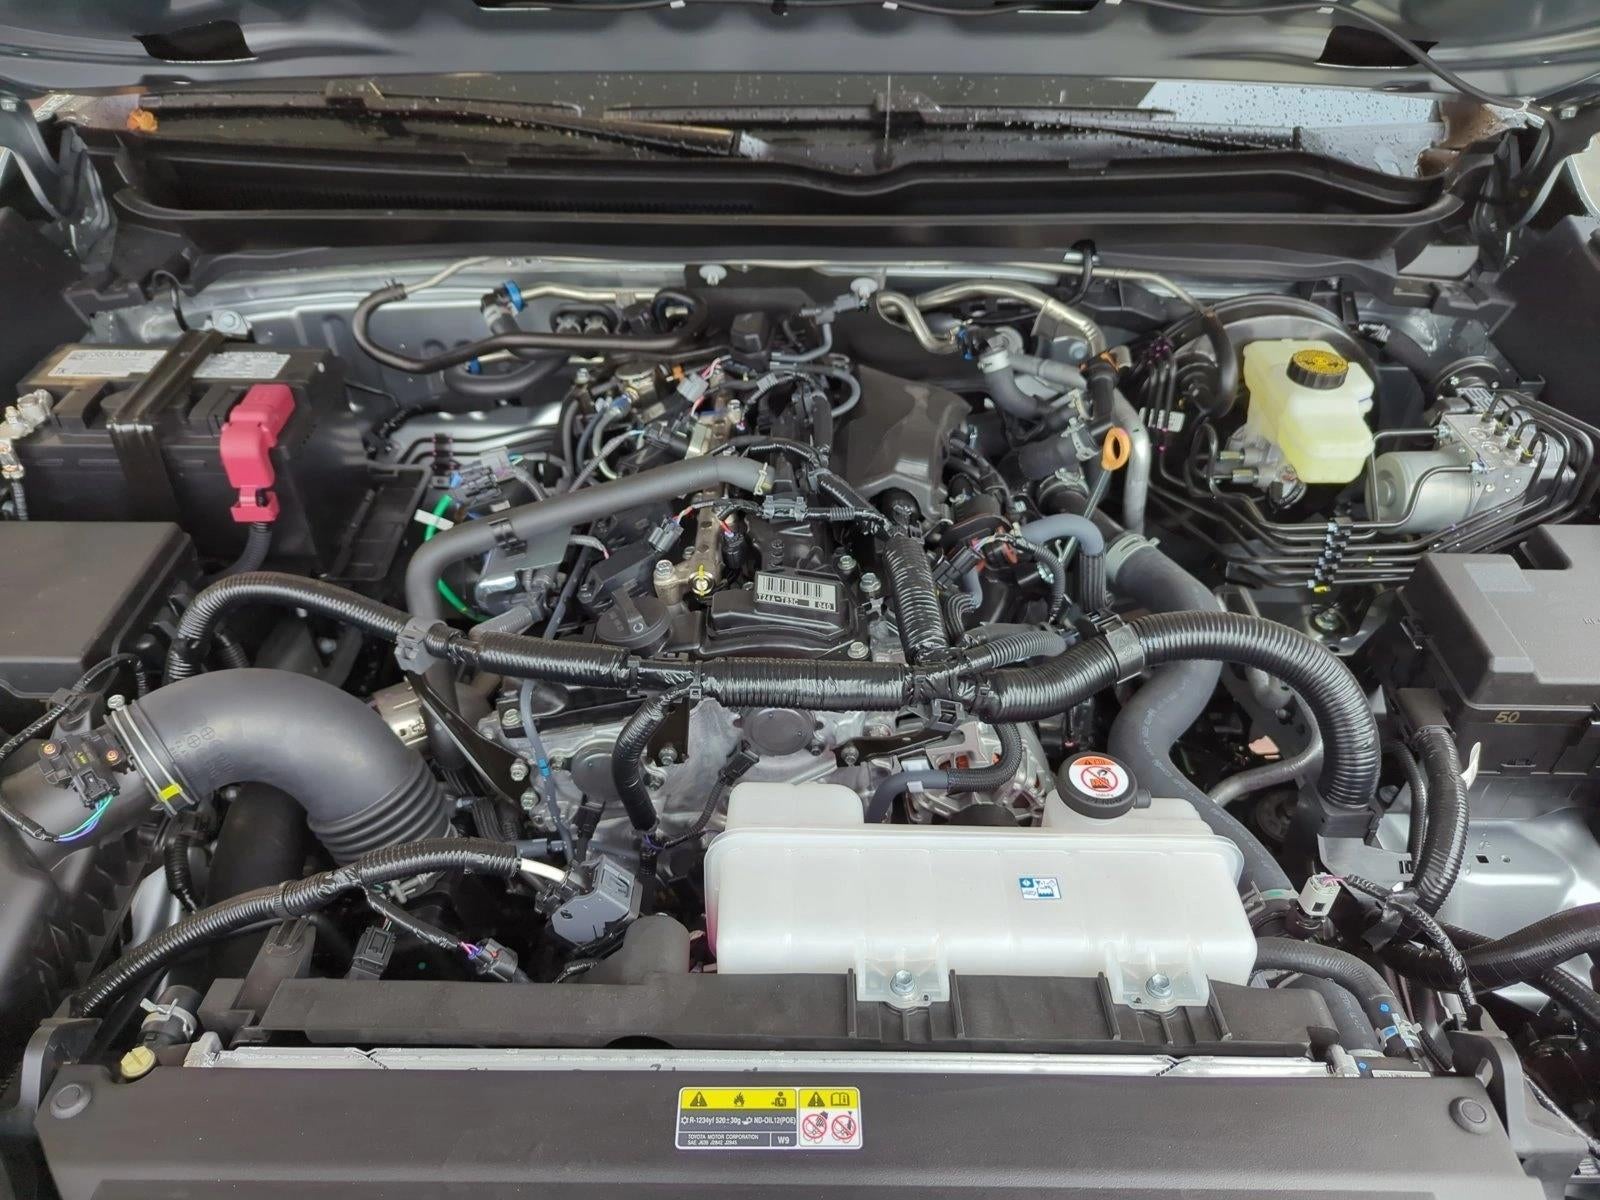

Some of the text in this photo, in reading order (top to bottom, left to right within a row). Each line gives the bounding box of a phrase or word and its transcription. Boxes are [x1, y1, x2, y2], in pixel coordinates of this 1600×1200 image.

[1495, 711, 1520, 723] 50
[690, 1116, 715, 1126] R-1234yf
[777, 1135, 790, 1145] W9
